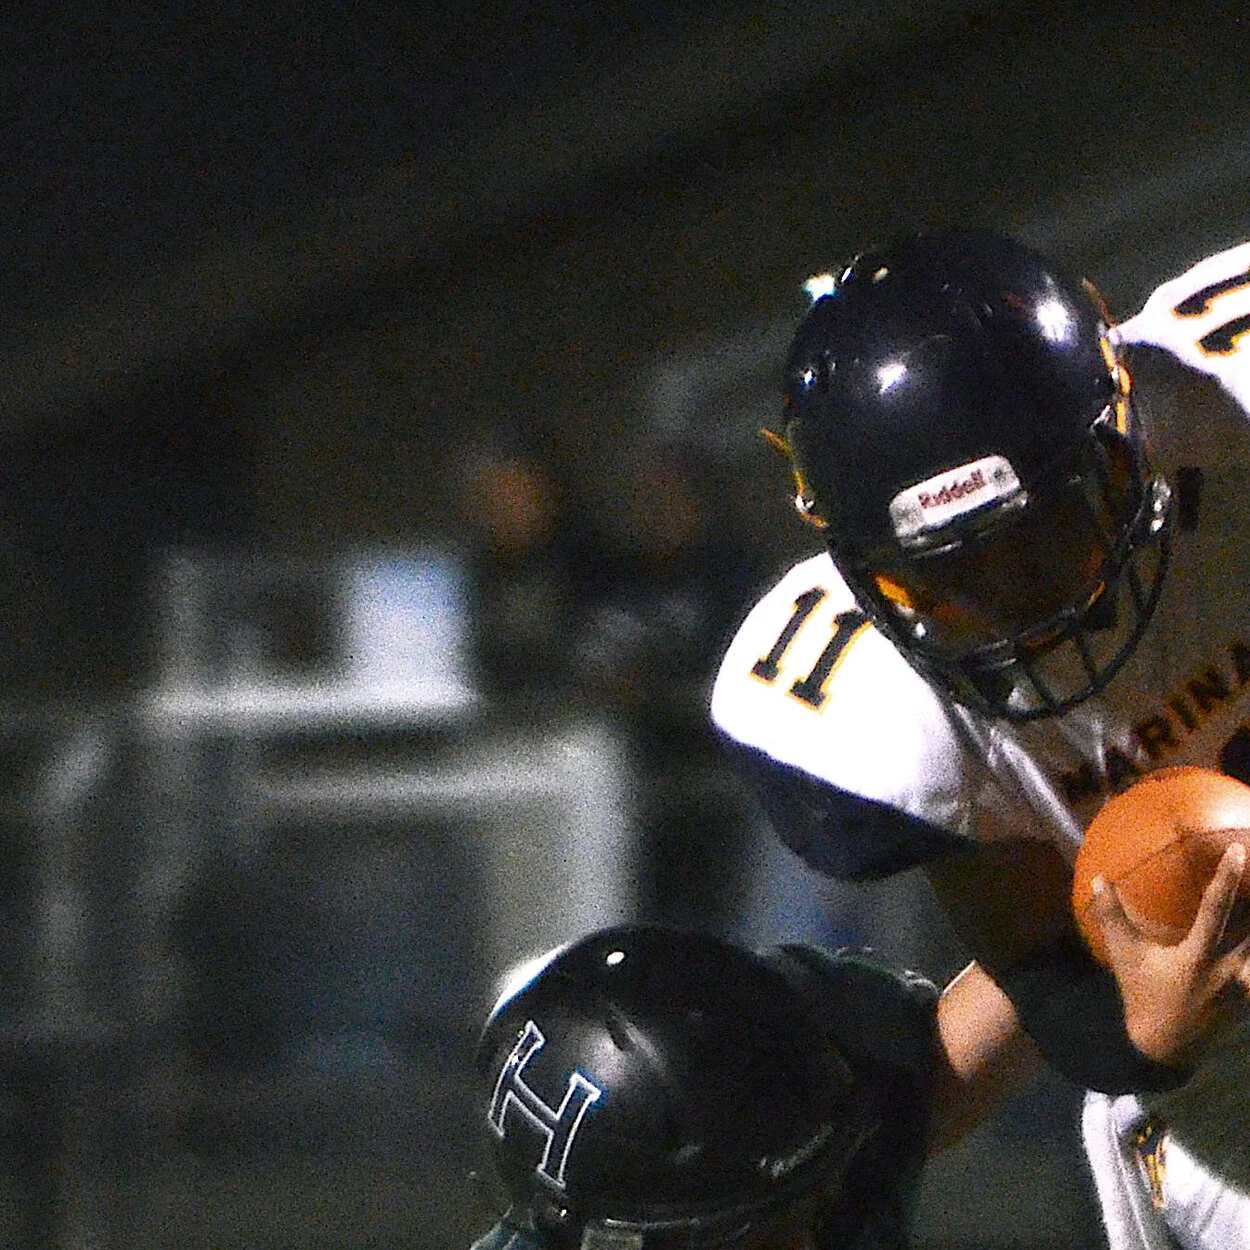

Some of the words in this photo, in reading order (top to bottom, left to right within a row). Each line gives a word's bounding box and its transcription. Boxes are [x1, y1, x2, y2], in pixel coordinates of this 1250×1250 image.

[917, 468, 987, 509] Riddell
[749, 584, 873, 713] 11
[487, 1019, 601, 1190] H
